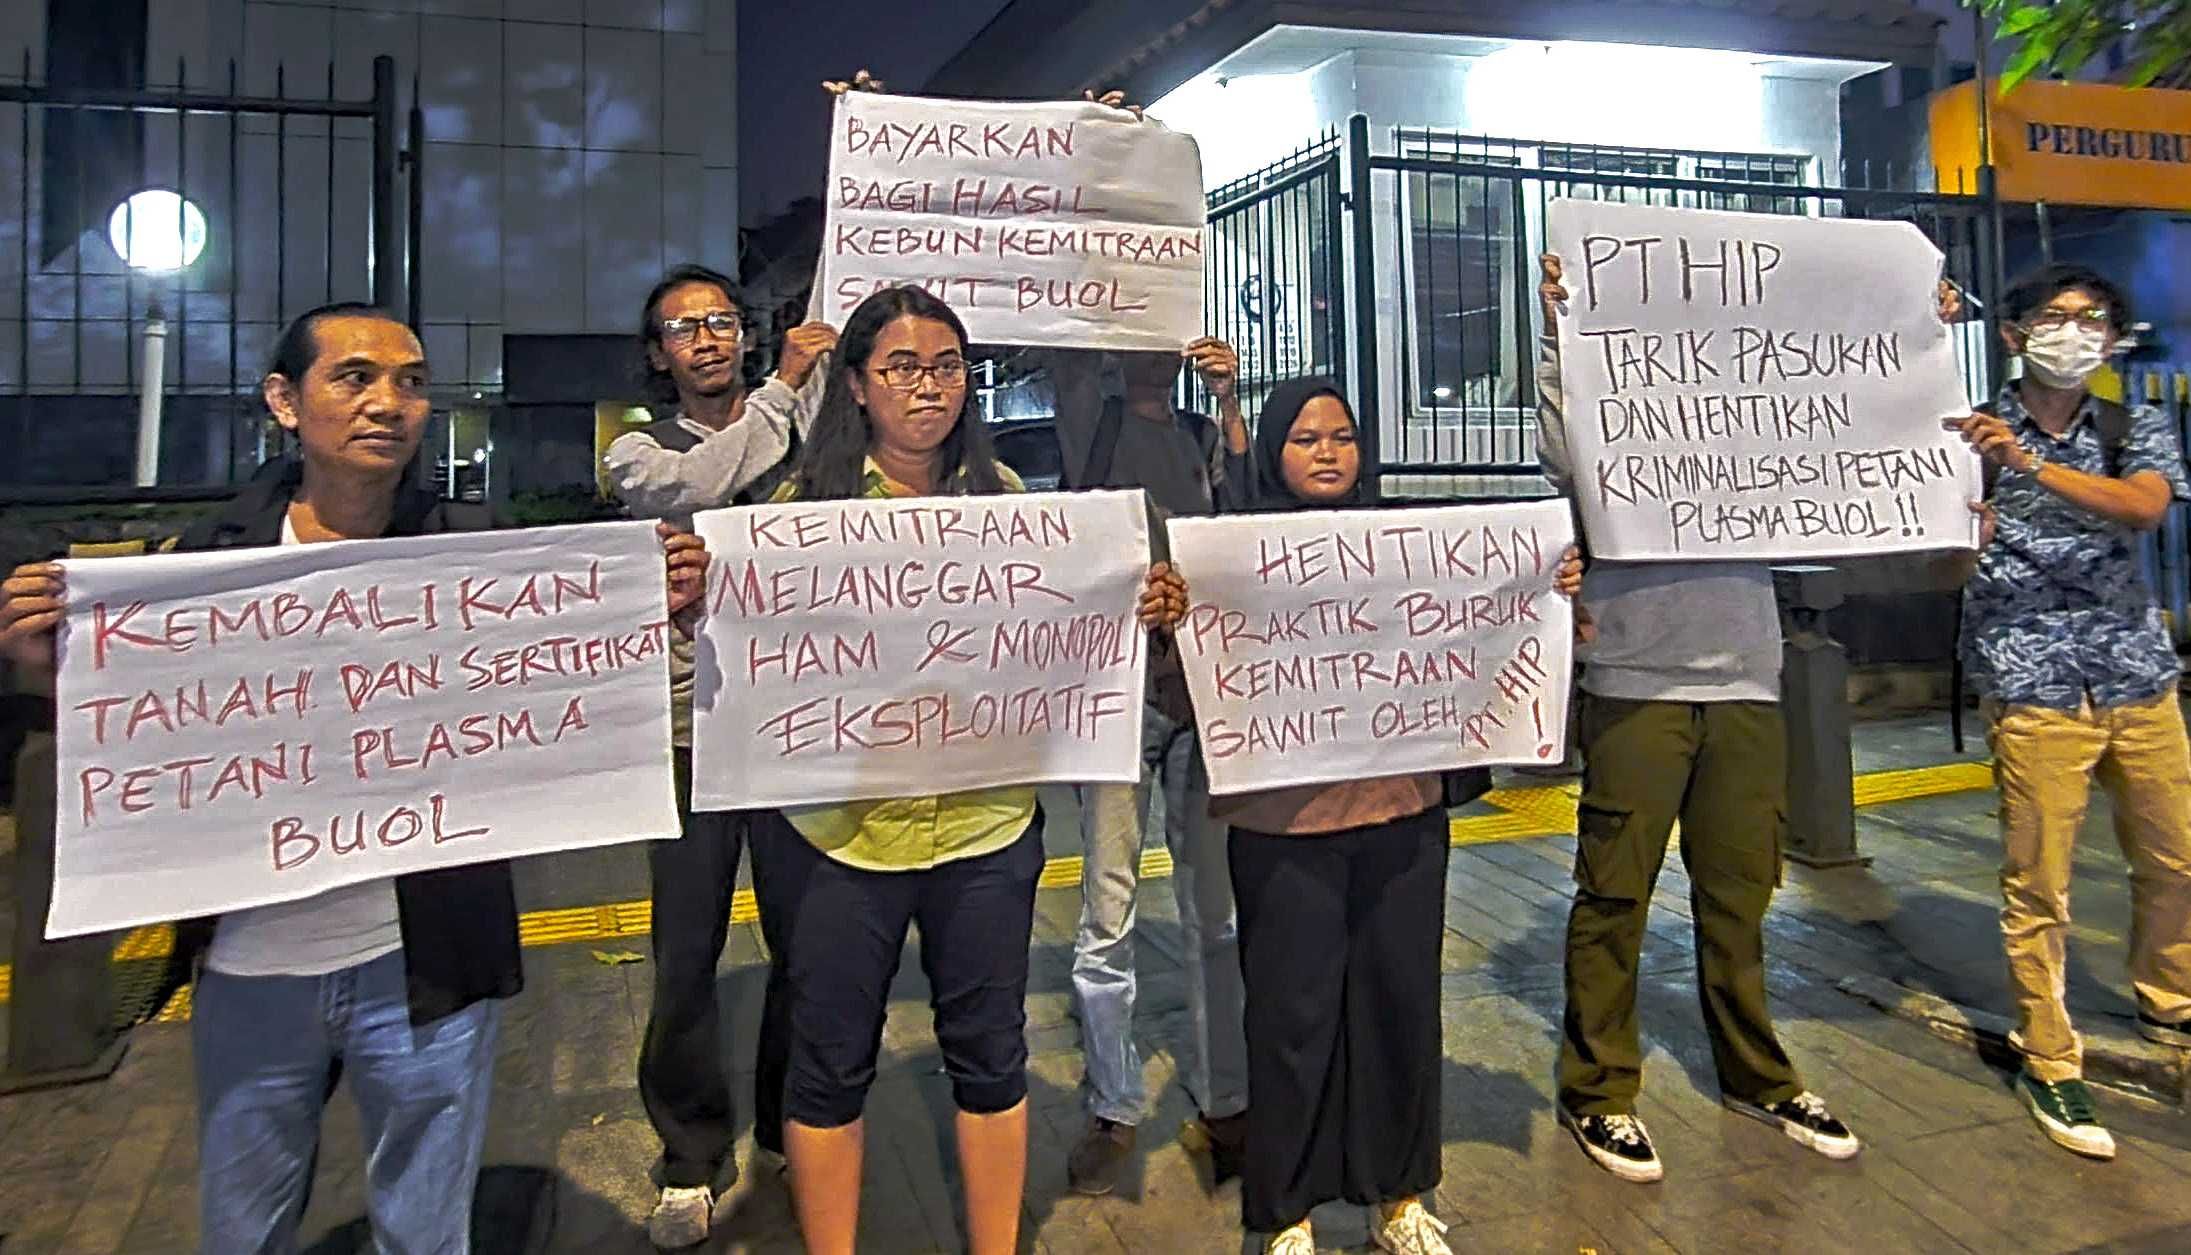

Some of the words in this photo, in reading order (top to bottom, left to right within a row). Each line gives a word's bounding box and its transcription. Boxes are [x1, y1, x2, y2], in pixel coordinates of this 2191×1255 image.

[847, 117, 1075, 162] BAYARKAN
[839, 176, 932, 213] BAGI
[952, 177, 1107, 216] HASIL
[835, 223, 984, 256] KEBUN
[999, 229, 1201, 262] KEMITRAAN
[1016, 276, 1147, 312] BUOL
[1582, 236, 1662, 311] PT
[1679, 237, 1781, 306] HIP
[1580, 328, 1719, 394] TARIK
[1733, 327, 1902, 384] PASUKAN
[1600, 395, 1671, 447] DAN
[1678, 392, 1852, 442] HENTIKAN
[1597, 452, 1830, 509] KRIMINALISASI
[1835, 448, 1954, 491] PETANI
[750, 507, 1073, 549] KEMITRAAN
[1257, 525, 1542, 586] HENTIKAN
[1671, 500, 1790, 552] PLASMA
[91, 560, 604, 670] KEMBALIKAN
[712, 558, 1075, 618] MELANGGAR
[750, 631, 879, 687] HAM
[916, 618, 981, 672] &
[990, 613, 1143, 673] MONOPOLI
[1185, 597, 1378, 656] PRAKTIK
[1394, 591, 1541, 638] BURUK
[75, 669, 312, 744] TANAH
[340, 652, 444, 714] DAN
[461, 620, 668, 692] SERTIFIKAT
[1206, 705, 1347, 758] SAWIT
[1371, 696, 1459, 739] OLEH
[1494, 636, 1547, 704] HIP
[1215, 647, 1478, 701] KEMITRAAN
[757, 683, 1126, 757] EKSPLOITATIF
[79, 744, 318, 824] PETANI
[352, 696, 591, 779] PLASMA
[272, 794, 489, 871] BUOL
